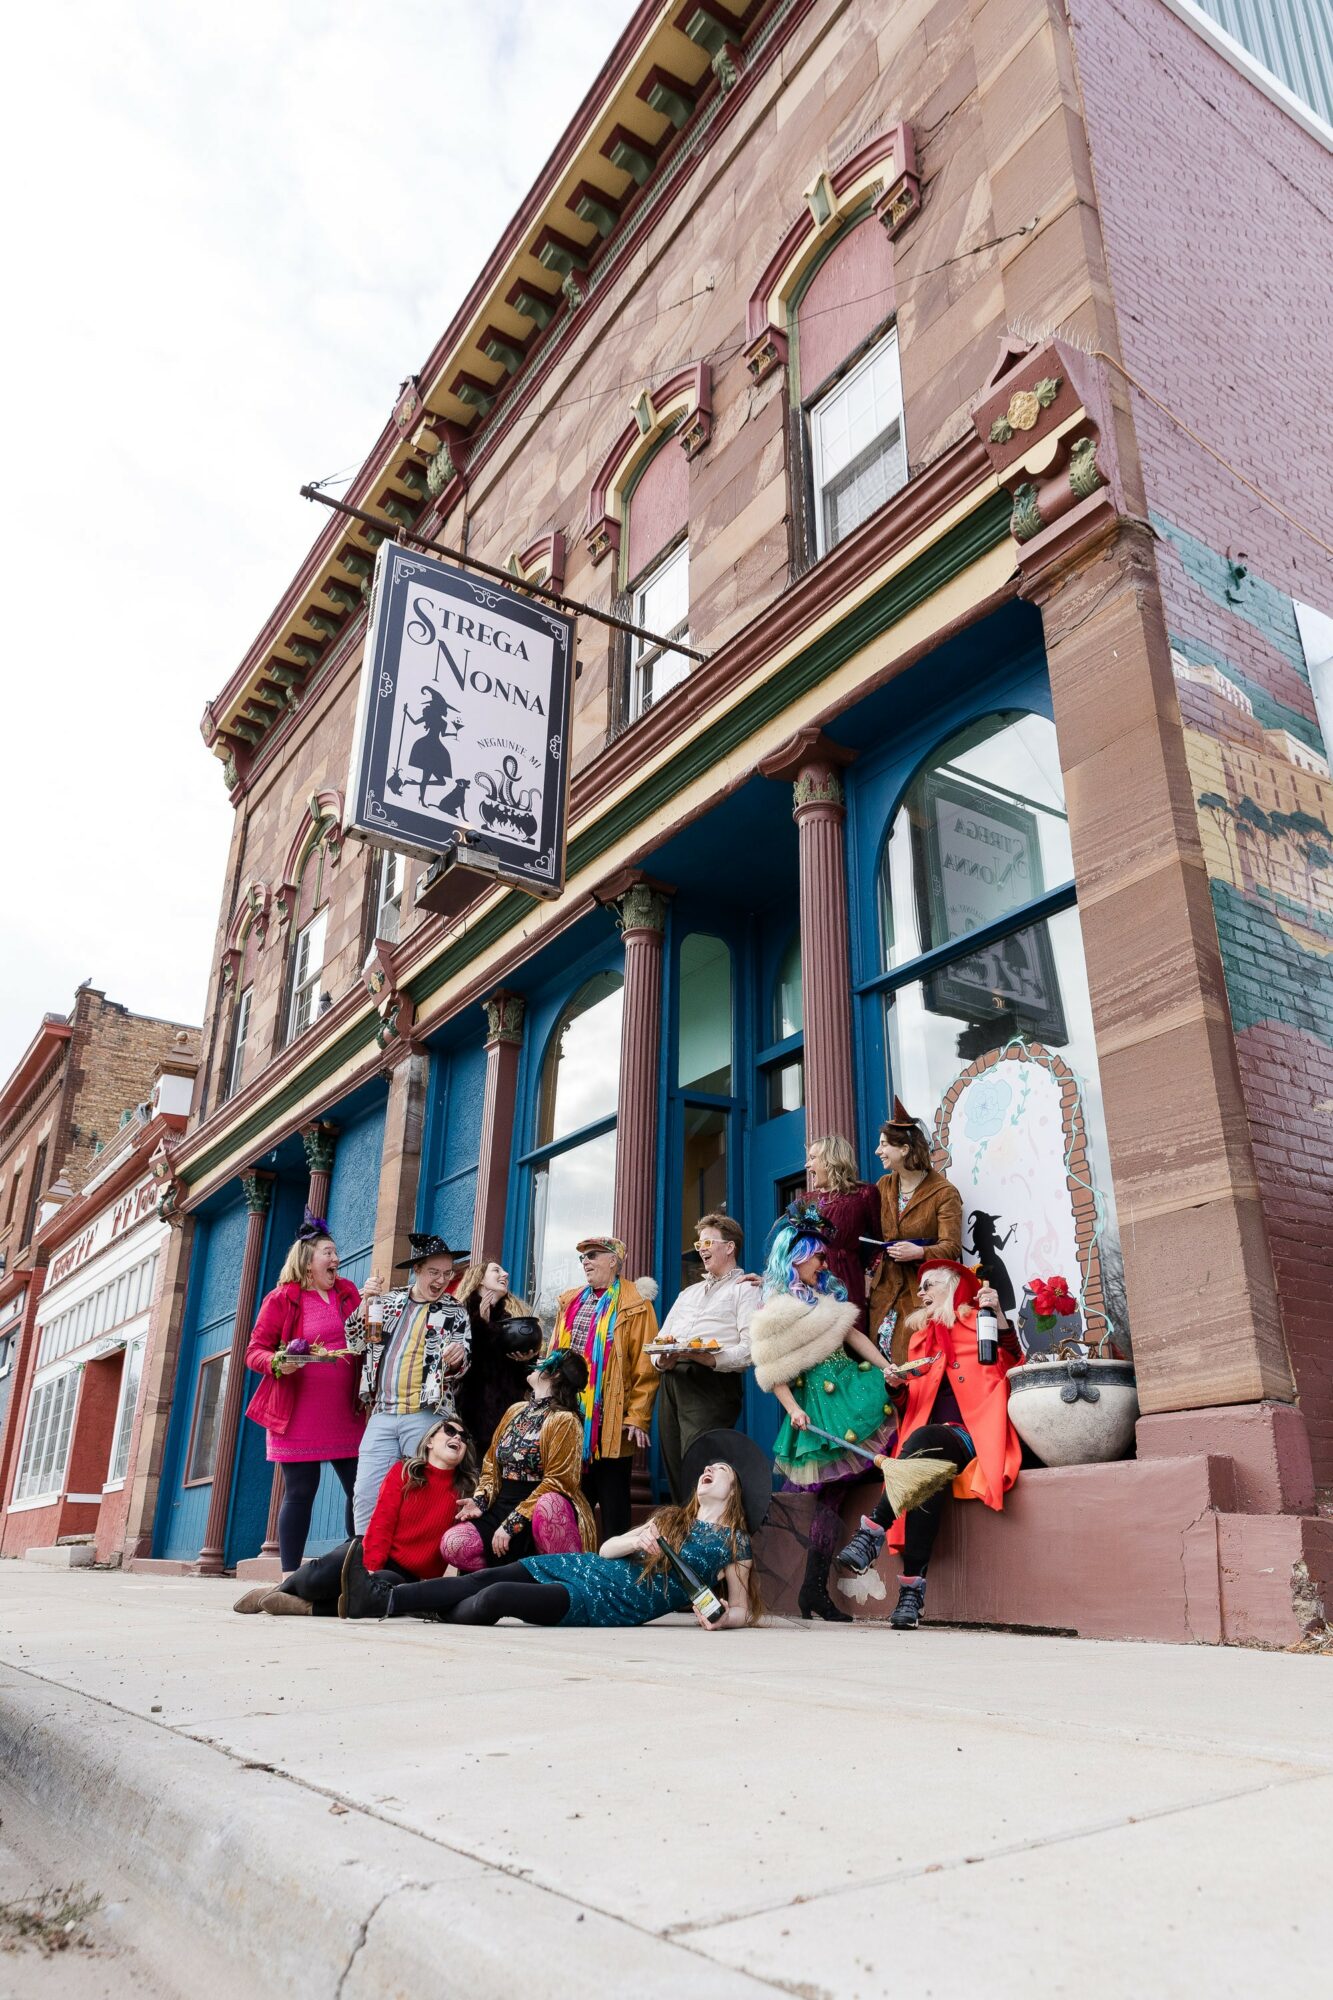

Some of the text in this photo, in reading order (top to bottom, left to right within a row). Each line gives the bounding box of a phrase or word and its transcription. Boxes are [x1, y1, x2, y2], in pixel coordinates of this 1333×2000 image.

[406, 597, 531, 662] STREGA
[432, 639, 547, 717] NONNA
[529, 755, 542, 769] MI
